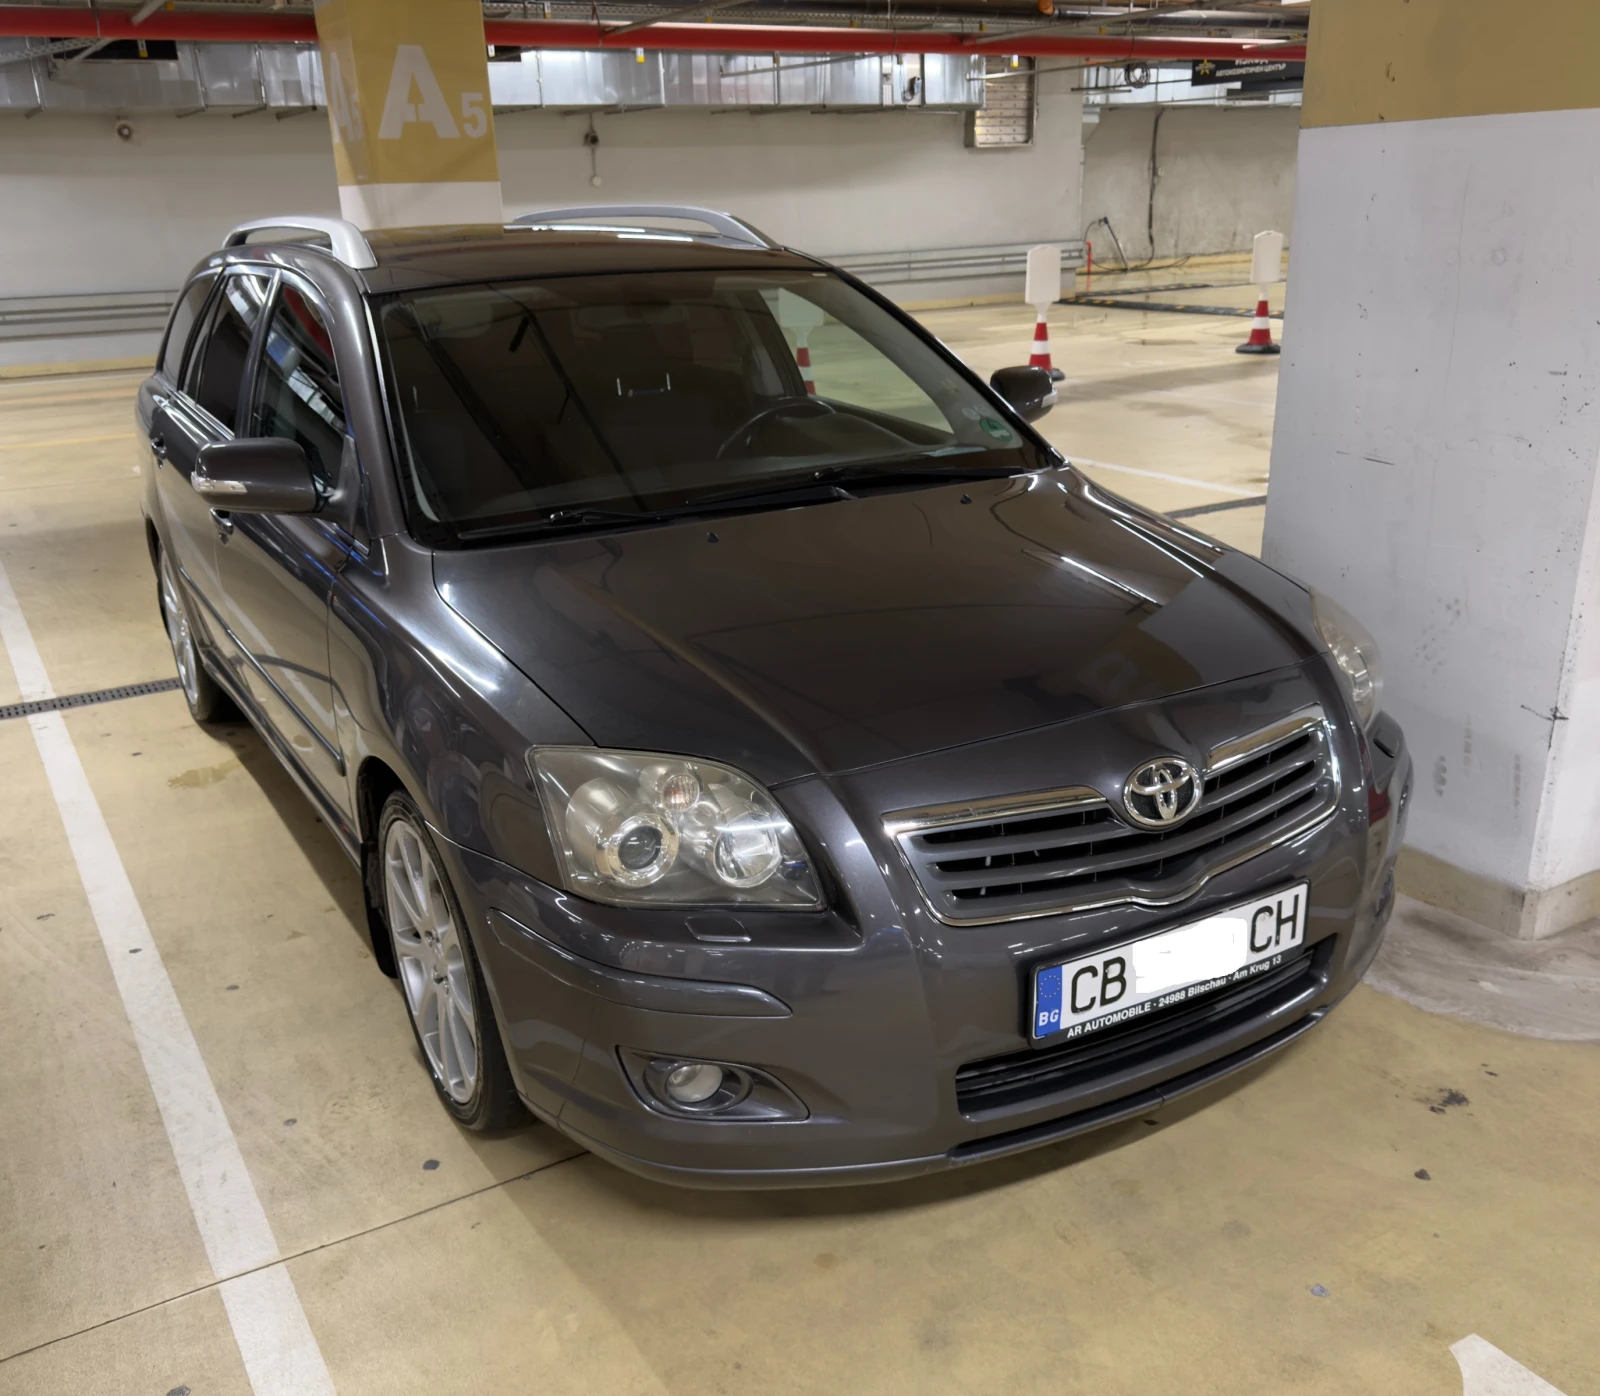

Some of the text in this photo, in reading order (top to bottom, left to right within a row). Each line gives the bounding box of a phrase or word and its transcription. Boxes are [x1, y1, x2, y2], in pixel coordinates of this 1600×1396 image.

[1070, 893, 1300, 1015] CB CH
[1039, 1009, 1060, 1026] BG
[1067, 955, 1282, 1039] AR AUTOMOBILE 24988 Bilschau Am Krug 13
